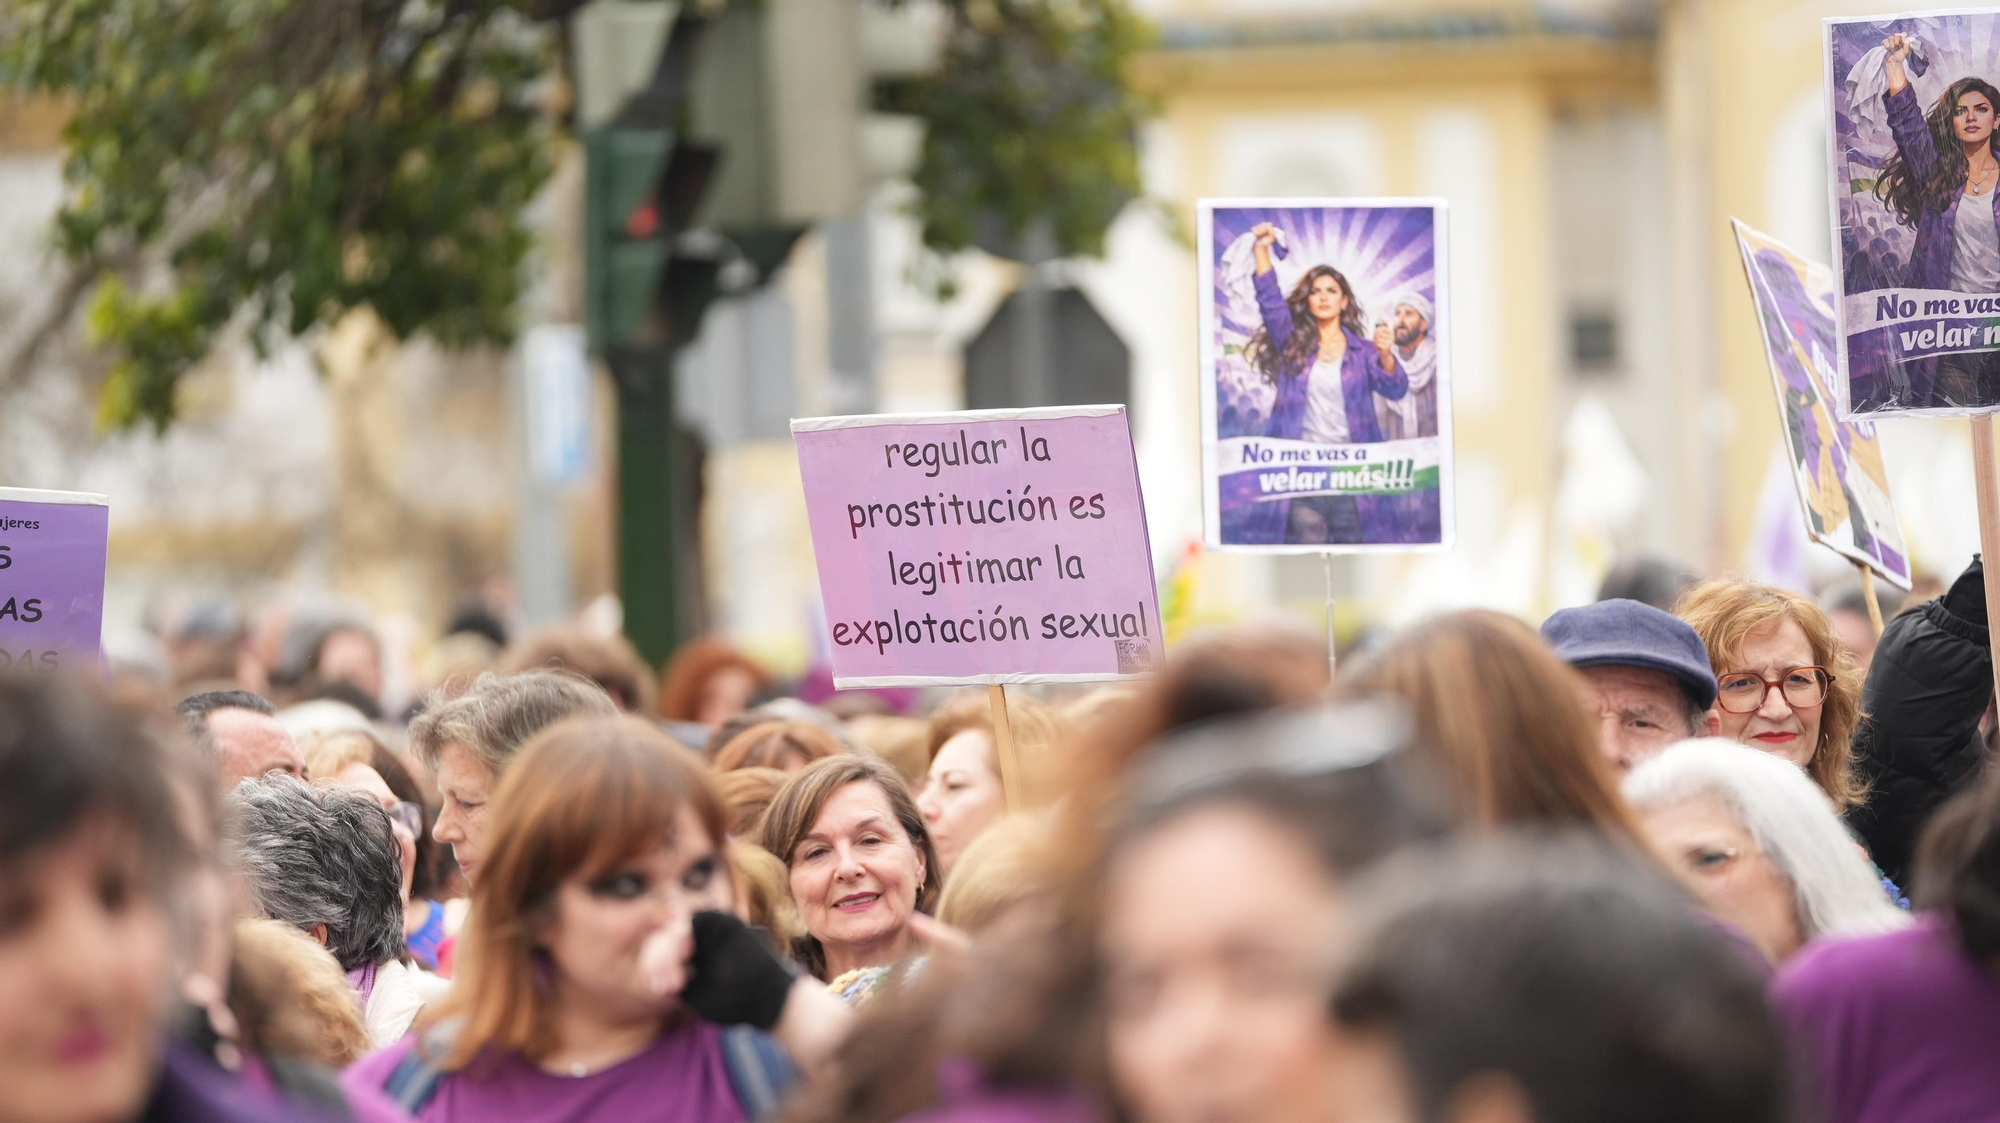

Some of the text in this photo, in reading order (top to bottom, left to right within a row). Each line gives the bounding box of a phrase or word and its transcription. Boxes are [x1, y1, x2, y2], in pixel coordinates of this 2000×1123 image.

[1876, 293, 1918, 321] No
[1924, 299, 1960, 316] me
[1899, 320, 1978, 352] velar
[884, 426, 1051, 478] regular la
[1241, 443, 1367, 464] No me vas a
[1258, 459, 1415, 493] velar más!!!
[847, 484, 1106, 539] prostitución es
[888, 544, 1086, 596] legitimar la
[832, 601, 1148, 656] explotación sexual
